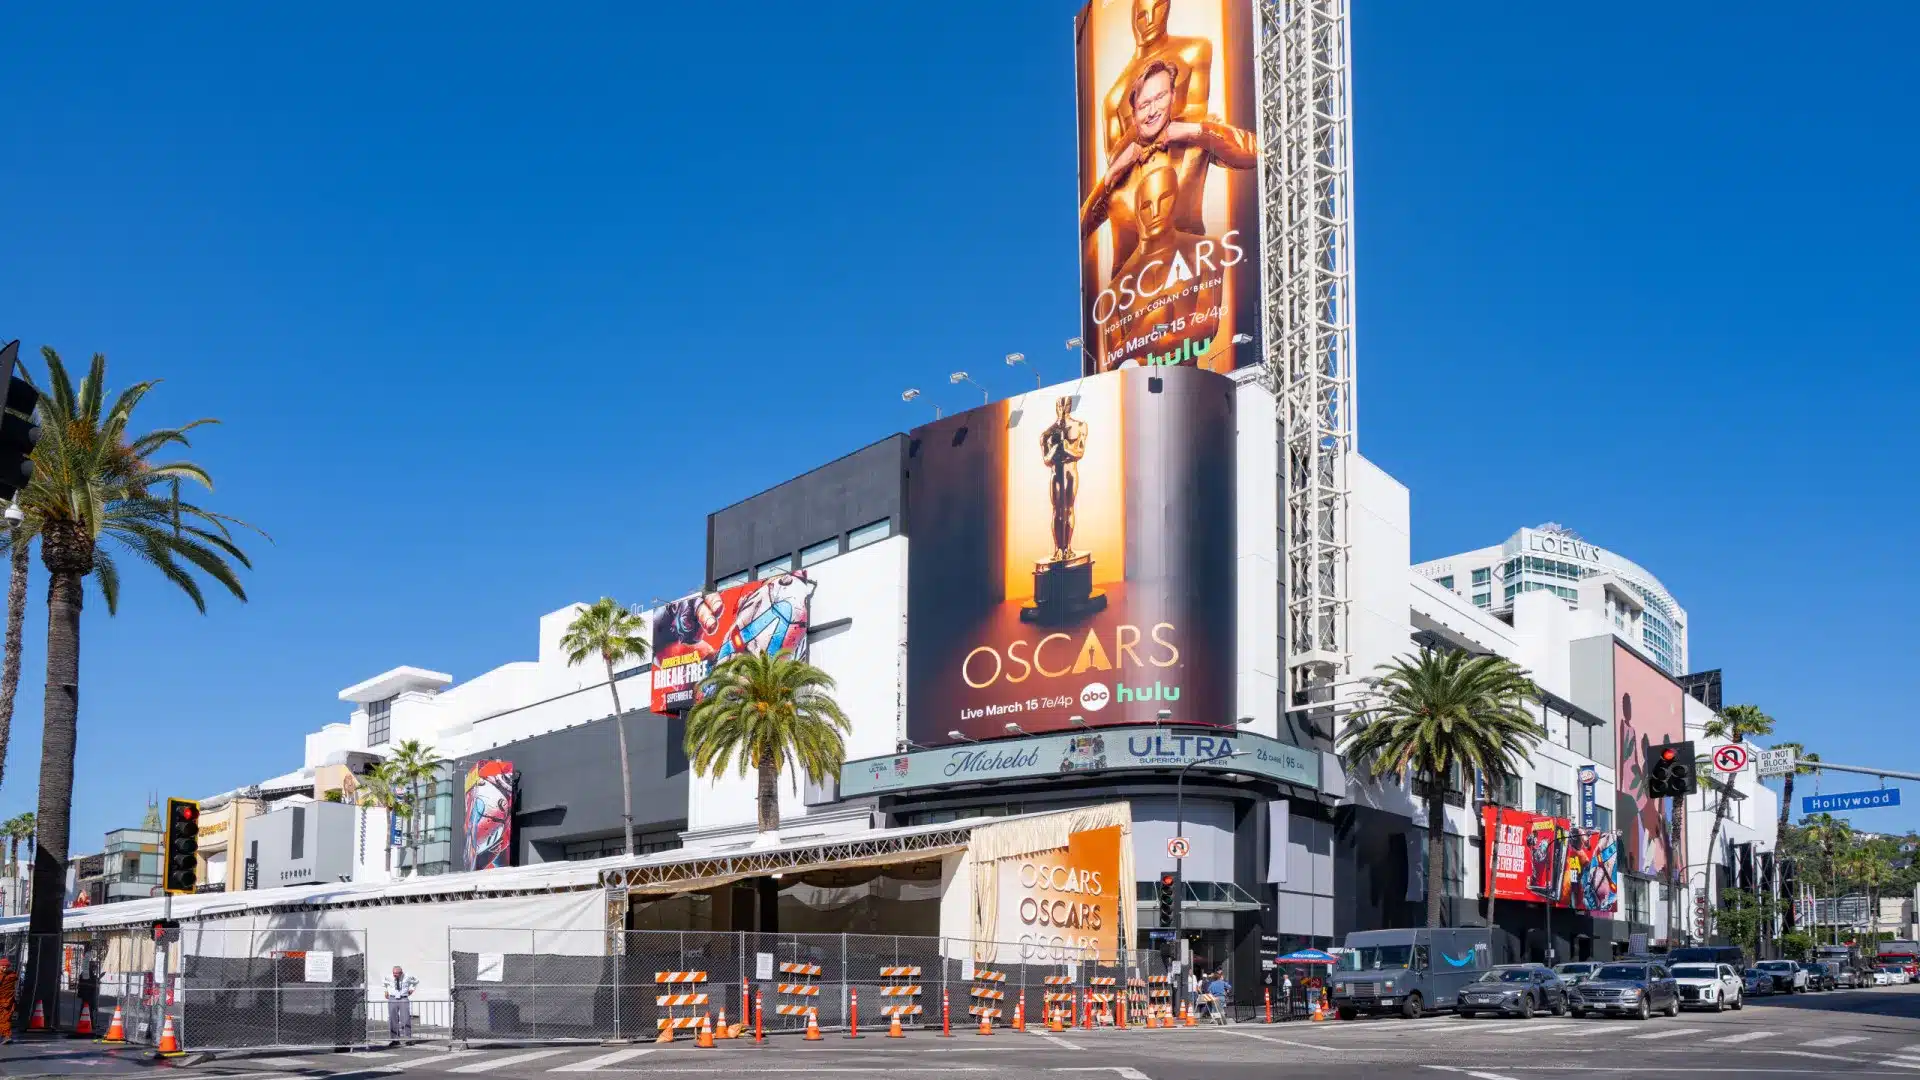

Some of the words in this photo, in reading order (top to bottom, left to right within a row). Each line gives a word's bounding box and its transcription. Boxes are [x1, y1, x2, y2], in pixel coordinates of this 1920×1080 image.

[1093, 230, 1243, 325] OSCARS
[1104, 314, 1132, 336] HOSTED
[1135, 308, 1145, 318] BY
[1147, 293, 1180, 312] CONAN
[1182, 277, 1222, 297] O'BRIEN
[1101, 347, 1123, 367] Live
[1170, 317, 1185, 333] 15
[1188, 305, 1229, 326] 7e/4p
[1147, 337, 1211, 366] hulu
[1529, 532, 1600, 562] LOEWS
[962, 622, 1179, 689] OSCARS
[654, 664, 686, 689] BREAK
[686, 660, 708, 684] FREE
[1082, 689, 1108, 702] abc
[1116, 680, 1180, 703] hulu
[961, 708, 983, 720] Live
[985, 701, 1023, 717] March
[1025, 699, 1038, 711] 15
[1041, 695, 1073, 709] 7e/4p
[1128, 735, 1236, 760] ULTRA
[1761, 752, 1771, 760] DO
[1774, 750, 1788, 758] NOT
[943, 746, 1040, 777] Michelob
[1286, 756, 1295, 769] 95
[1760, 765, 1794, 773] INTERSECTION
[1764, 758, 1788, 767] BLOCK
[1812, 793, 1890, 809] Hollywood
[1585, 819, 1593, 827] EAT
[394, 836, 402, 845] EAT
[280, 868, 311, 880] SEPHORA
[1019, 863, 1102, 897] OSCARS
[1019, 897, 1102, 931] OSCARS
[1017, 931, 1101, 961] OSCARS
